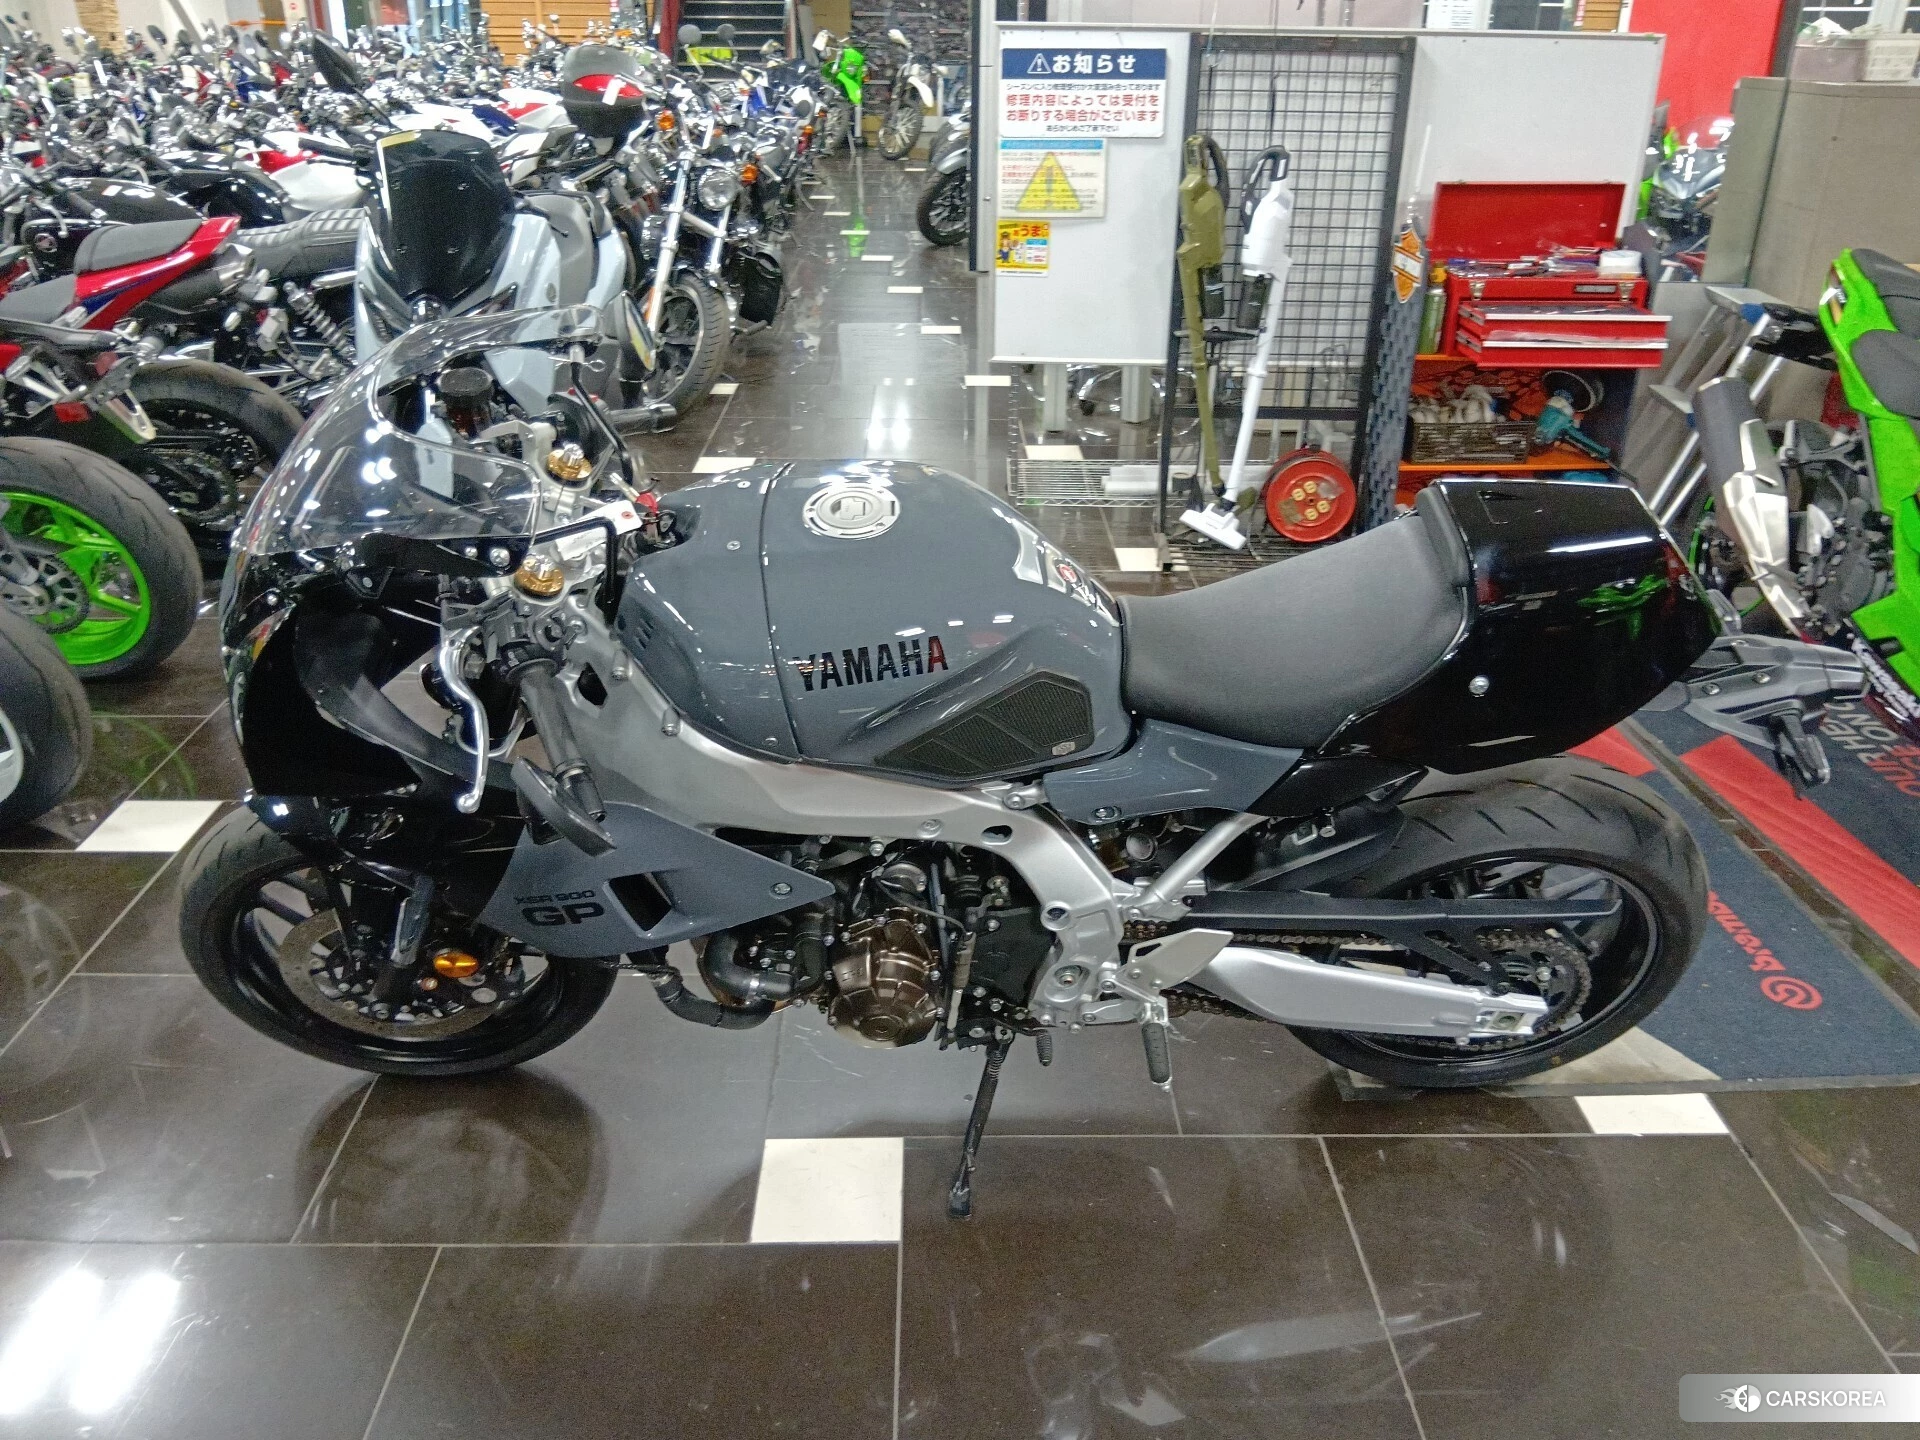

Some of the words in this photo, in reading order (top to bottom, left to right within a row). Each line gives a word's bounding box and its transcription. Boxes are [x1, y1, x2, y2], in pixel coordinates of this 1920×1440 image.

[1052, 53, 1136, 74] お知らせ
[1006, 94, 1159, 106] 修理内容によっては受付を
[1006, 109, 1160, 122] お断りする場合がございます
[792, 635, 949, 691] YAMAHA
[514, 894, 553, 905] XSR
[555, 889, 595, 901] 900
[522, 901, 605, 926] GP
